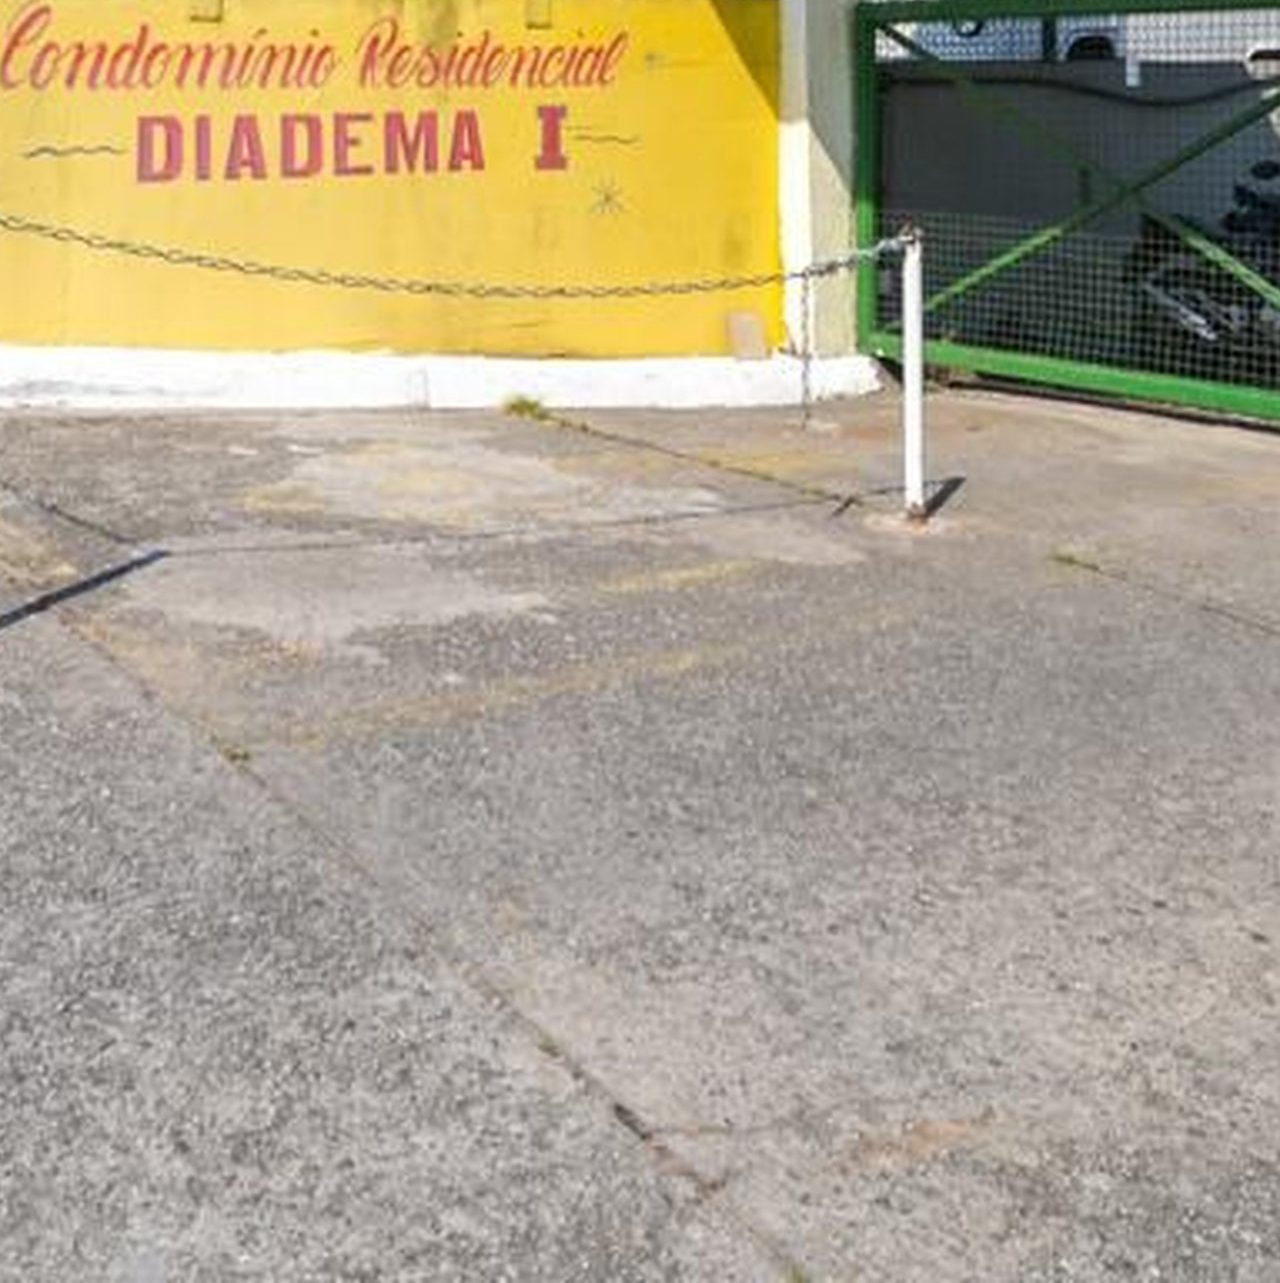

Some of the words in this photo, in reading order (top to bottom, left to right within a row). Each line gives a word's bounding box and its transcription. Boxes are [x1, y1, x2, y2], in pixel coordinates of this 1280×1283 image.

[356, 16, 628, 91] Residencial
[136, 109, 486, 184] DIADEMA
[534, 105, 569, 172] I
